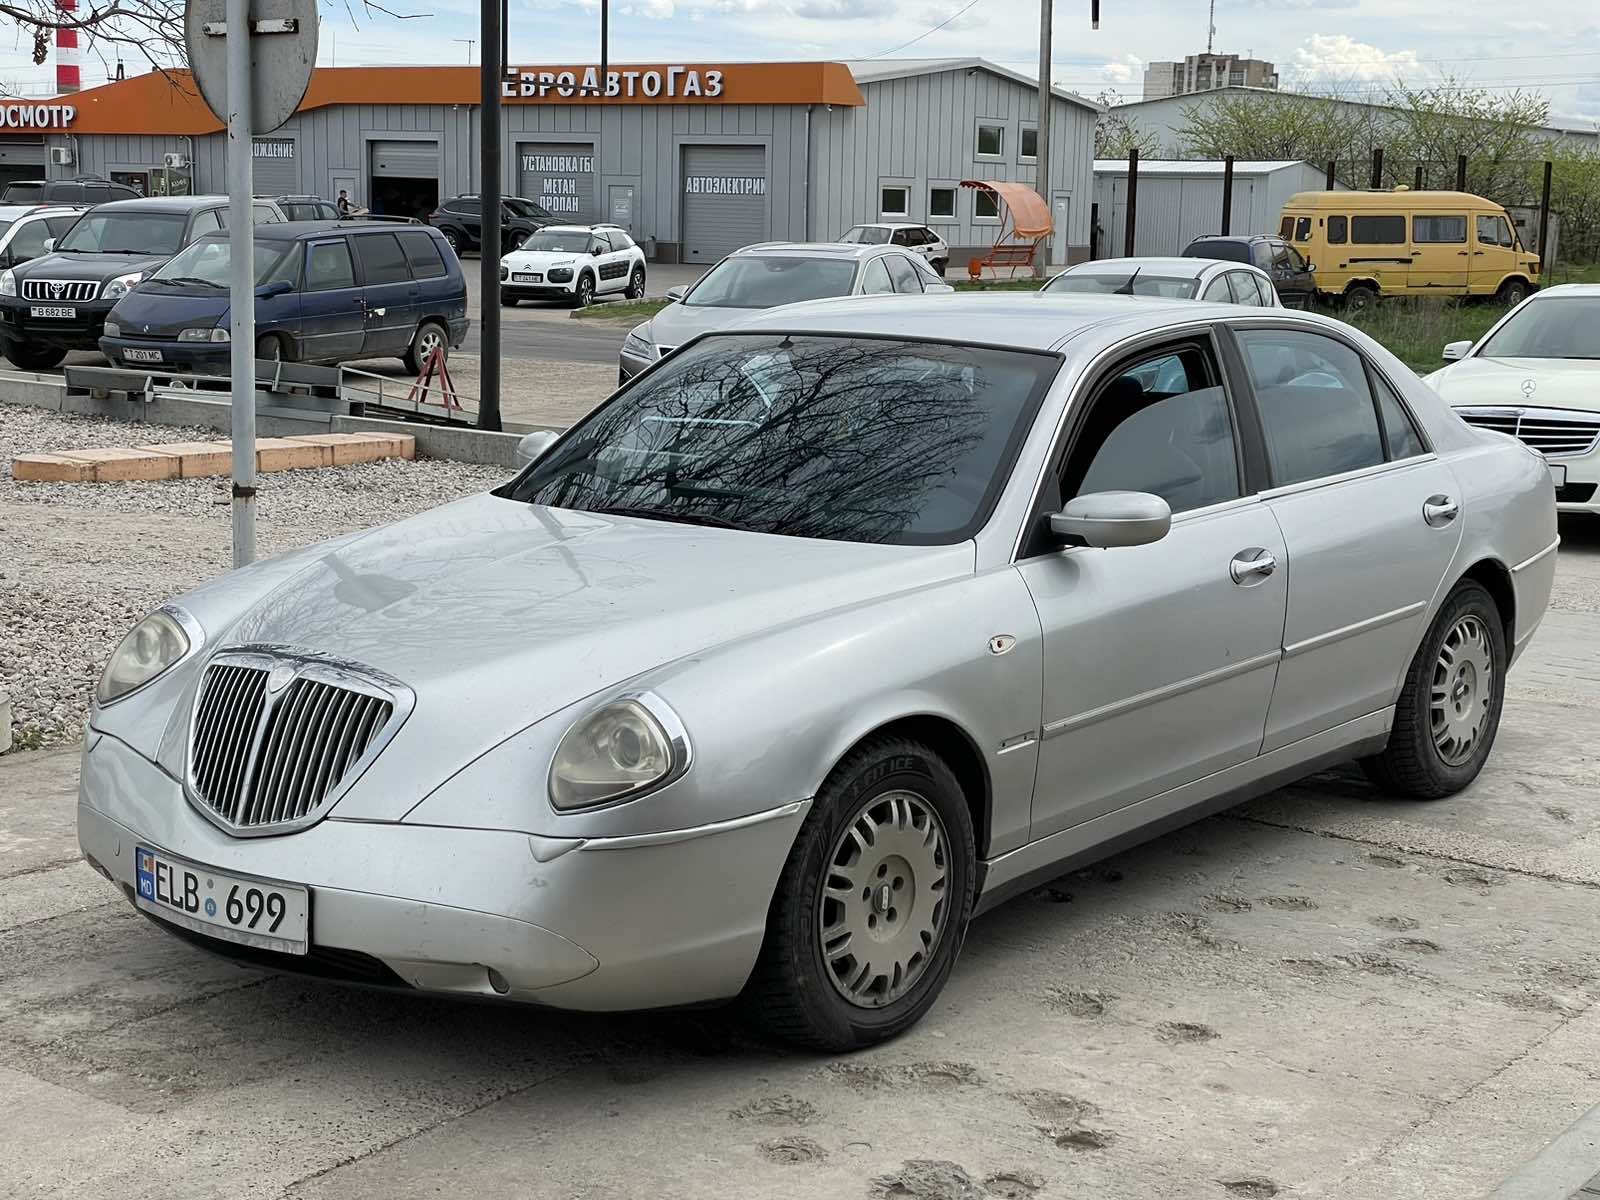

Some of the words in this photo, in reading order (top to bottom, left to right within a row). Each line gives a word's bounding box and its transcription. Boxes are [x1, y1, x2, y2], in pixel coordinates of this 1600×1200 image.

[251, 143, 294, 158] ОЖДЕНИЕ
[522, 155, 578, 172] УСТАНОВКА
[543, 179, 576, 194] МЕТАН
[540, 196, 579, 212] ПРОПАН
[45, 308, 60, 317] 682
[61, 308, 73, 317] BE
[140, 877, 153, 896] MD
[155, 860, 200, 914] ELB
[225, 884, 287, 934] 699
